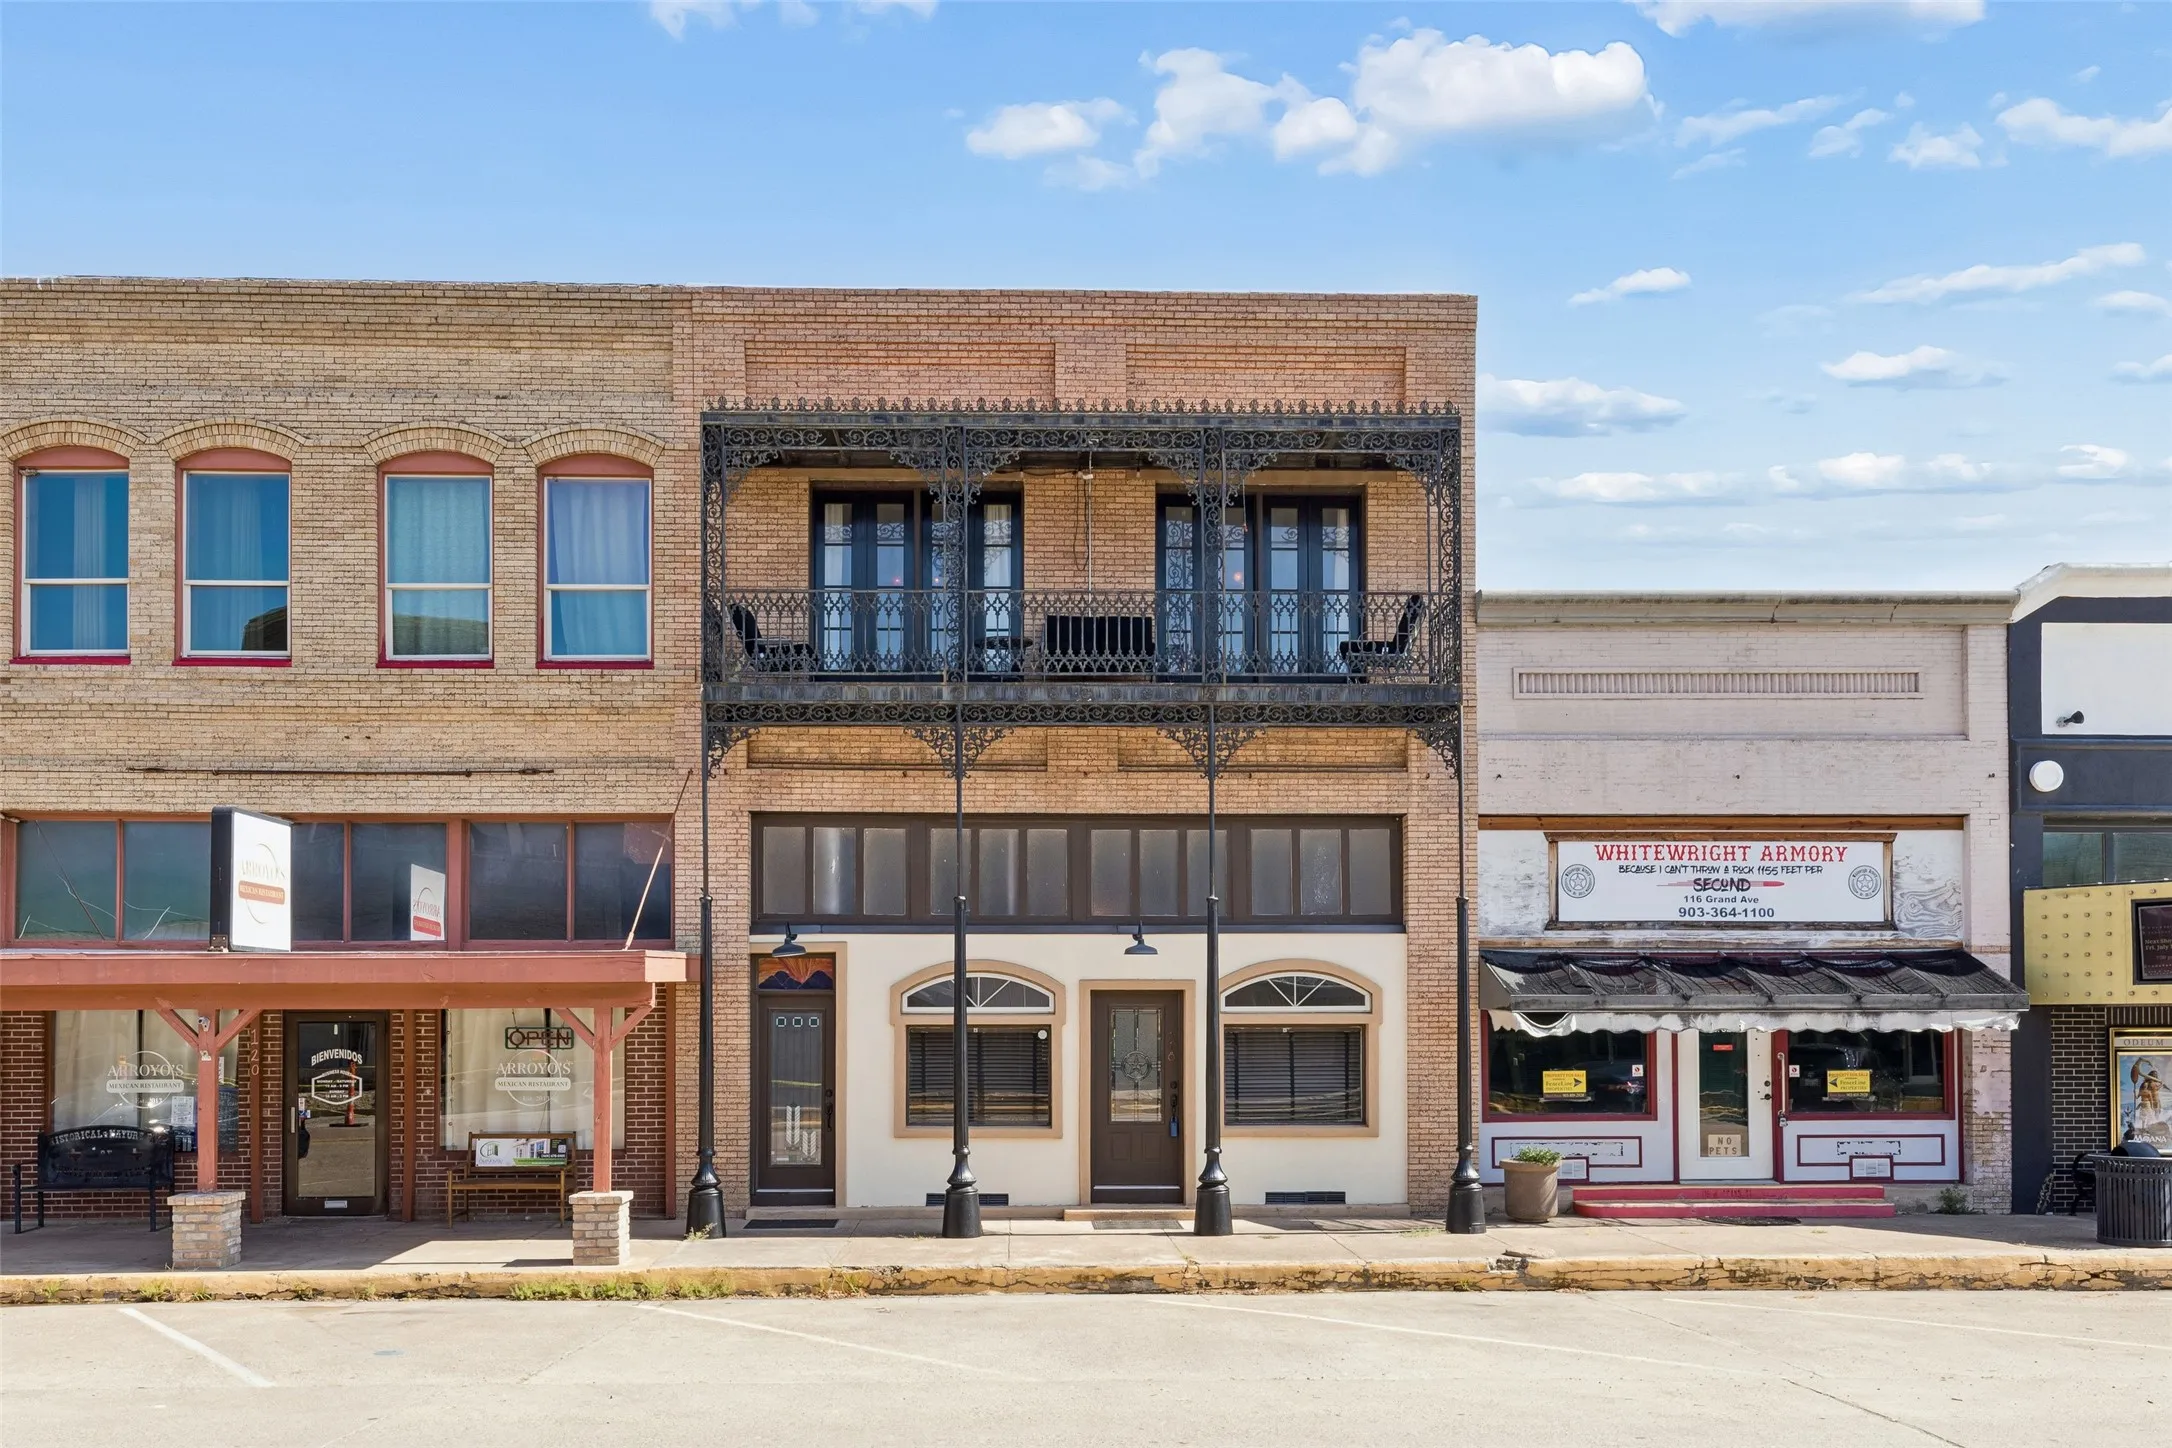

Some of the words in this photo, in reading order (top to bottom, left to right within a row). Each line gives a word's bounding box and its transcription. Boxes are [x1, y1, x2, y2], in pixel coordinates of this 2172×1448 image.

[1594, 844, 1751, 861] WHITEWRIGHT
[1760, 845, 1848, 862] ARMORY
[1618, 864, 1657, 874] BECAUSE
[1664, 864, 1688, 874] CAN'T
[1690, 865, 1721, 874] THROW
[1723, 866, 1730, 874] A
[1732, 865, 1755, 874] ROCK
[1757, 865, 1779, 876] 1155
[1780, 866, 1803, 874] FEET
[1804, 866, 1824, 874] PER
[1692, 878, 1751, 892] SECOND
[1684, 895, 1703, 903] 116
[1705, 895, 1737, 904] Grand
[1740, 896, 1759, 904] Ave
[1678, 907, 1775, 918] 903-364-1100
[509, 1030, 570, 1046] OPEN
[311, 1048, 363, 1067] BIENVENIDOS
[107, 1064, 184, 1077] ARROYO'S
[496, 1062, 571, 1075] ARROYO'S
[1717, 1136, 1732, 1146] NO
[2133, 1135, 2167, 1143] MOANA
[1709, 1147, 1737, 1155] PETS
